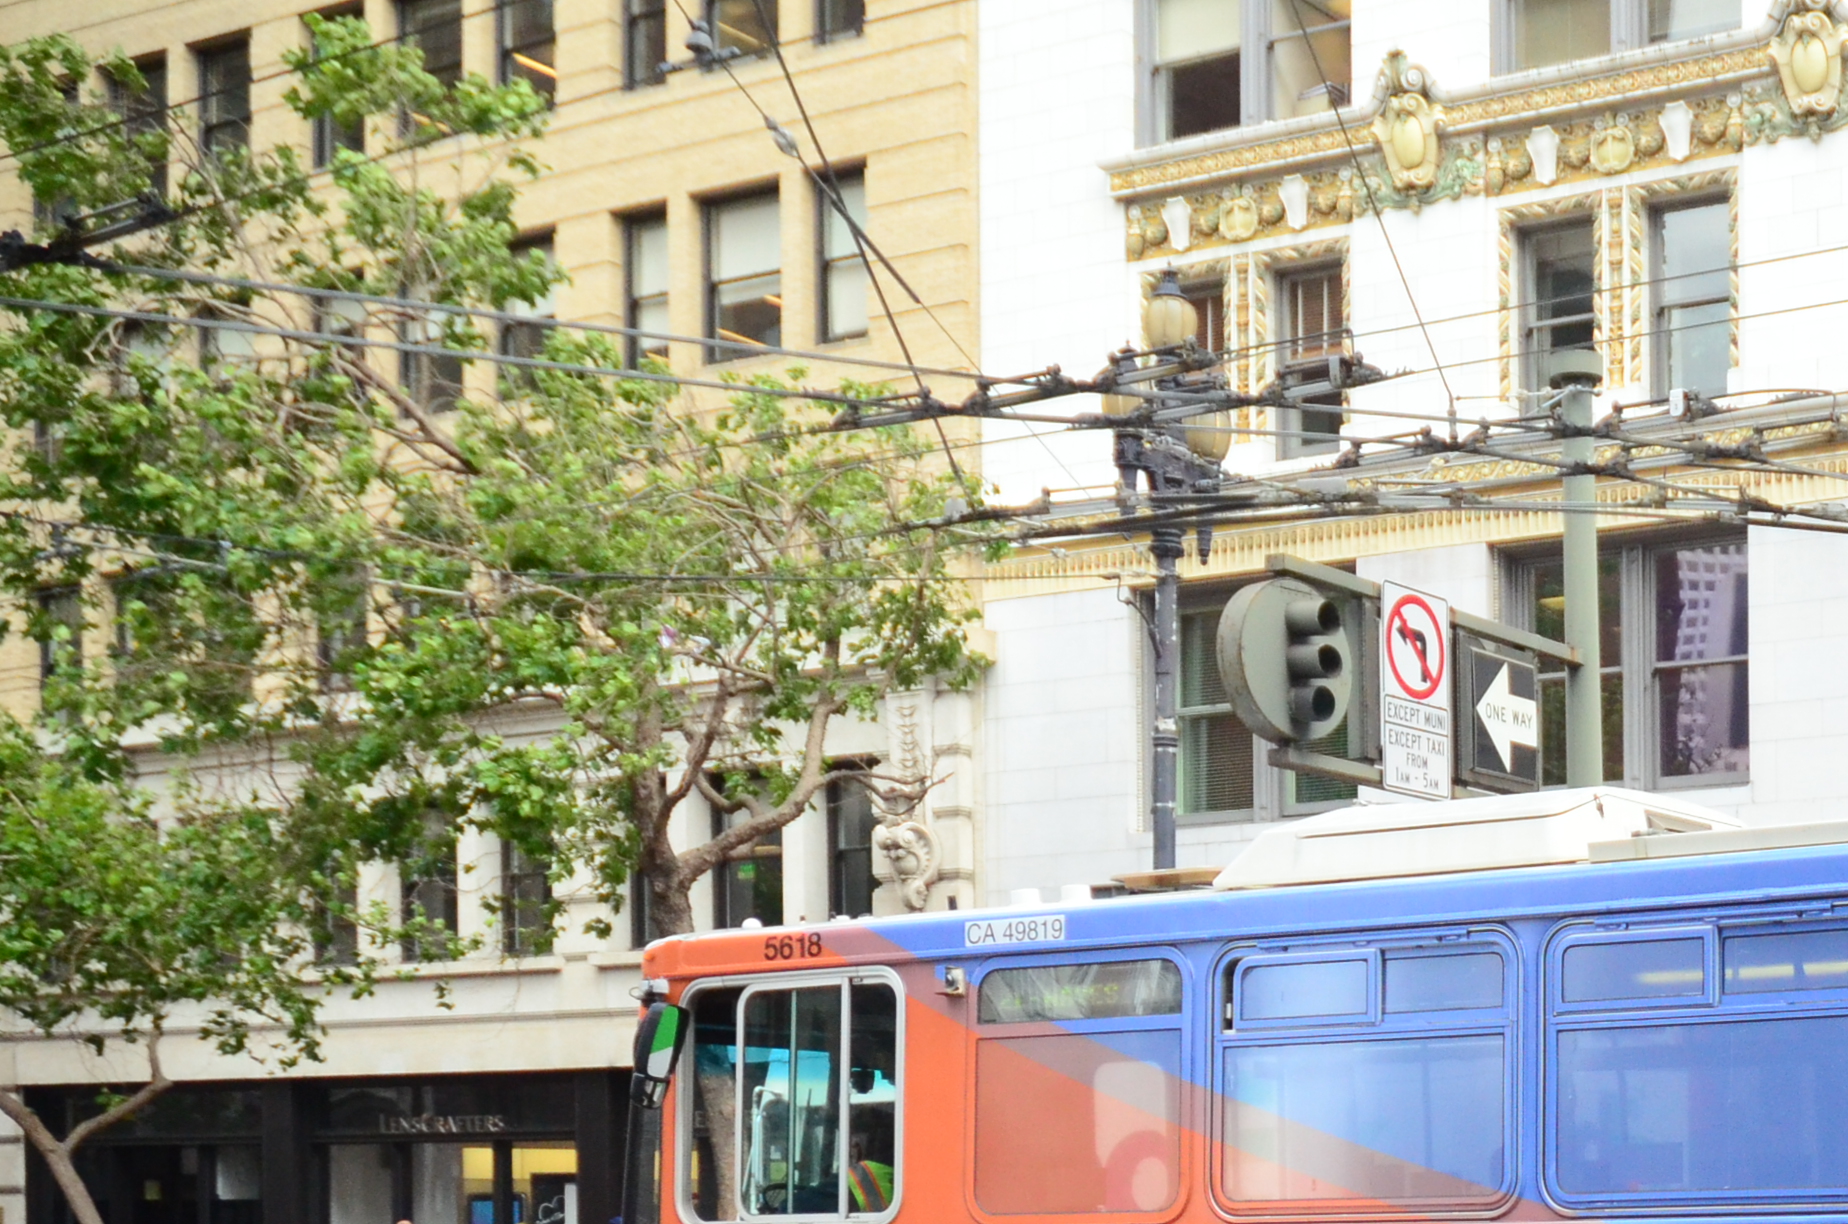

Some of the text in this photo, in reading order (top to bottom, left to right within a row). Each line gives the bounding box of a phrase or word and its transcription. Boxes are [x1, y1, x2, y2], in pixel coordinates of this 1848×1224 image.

[1387, 702, 1446, 731] EXCEPT MUNI
[1485, 702, 1533, 729] ONE WAY
[1388, 728, 1445, 757] EXCEPT TAXI
[1406, 752, 1428, 770] FROM
[1395, 766, 1411, 784] 1AM
[1423, 772, 1439, 790] 5AM
[967, 917, 1064, 945] CA 49819
[764, 932, 822, 961] 5618
